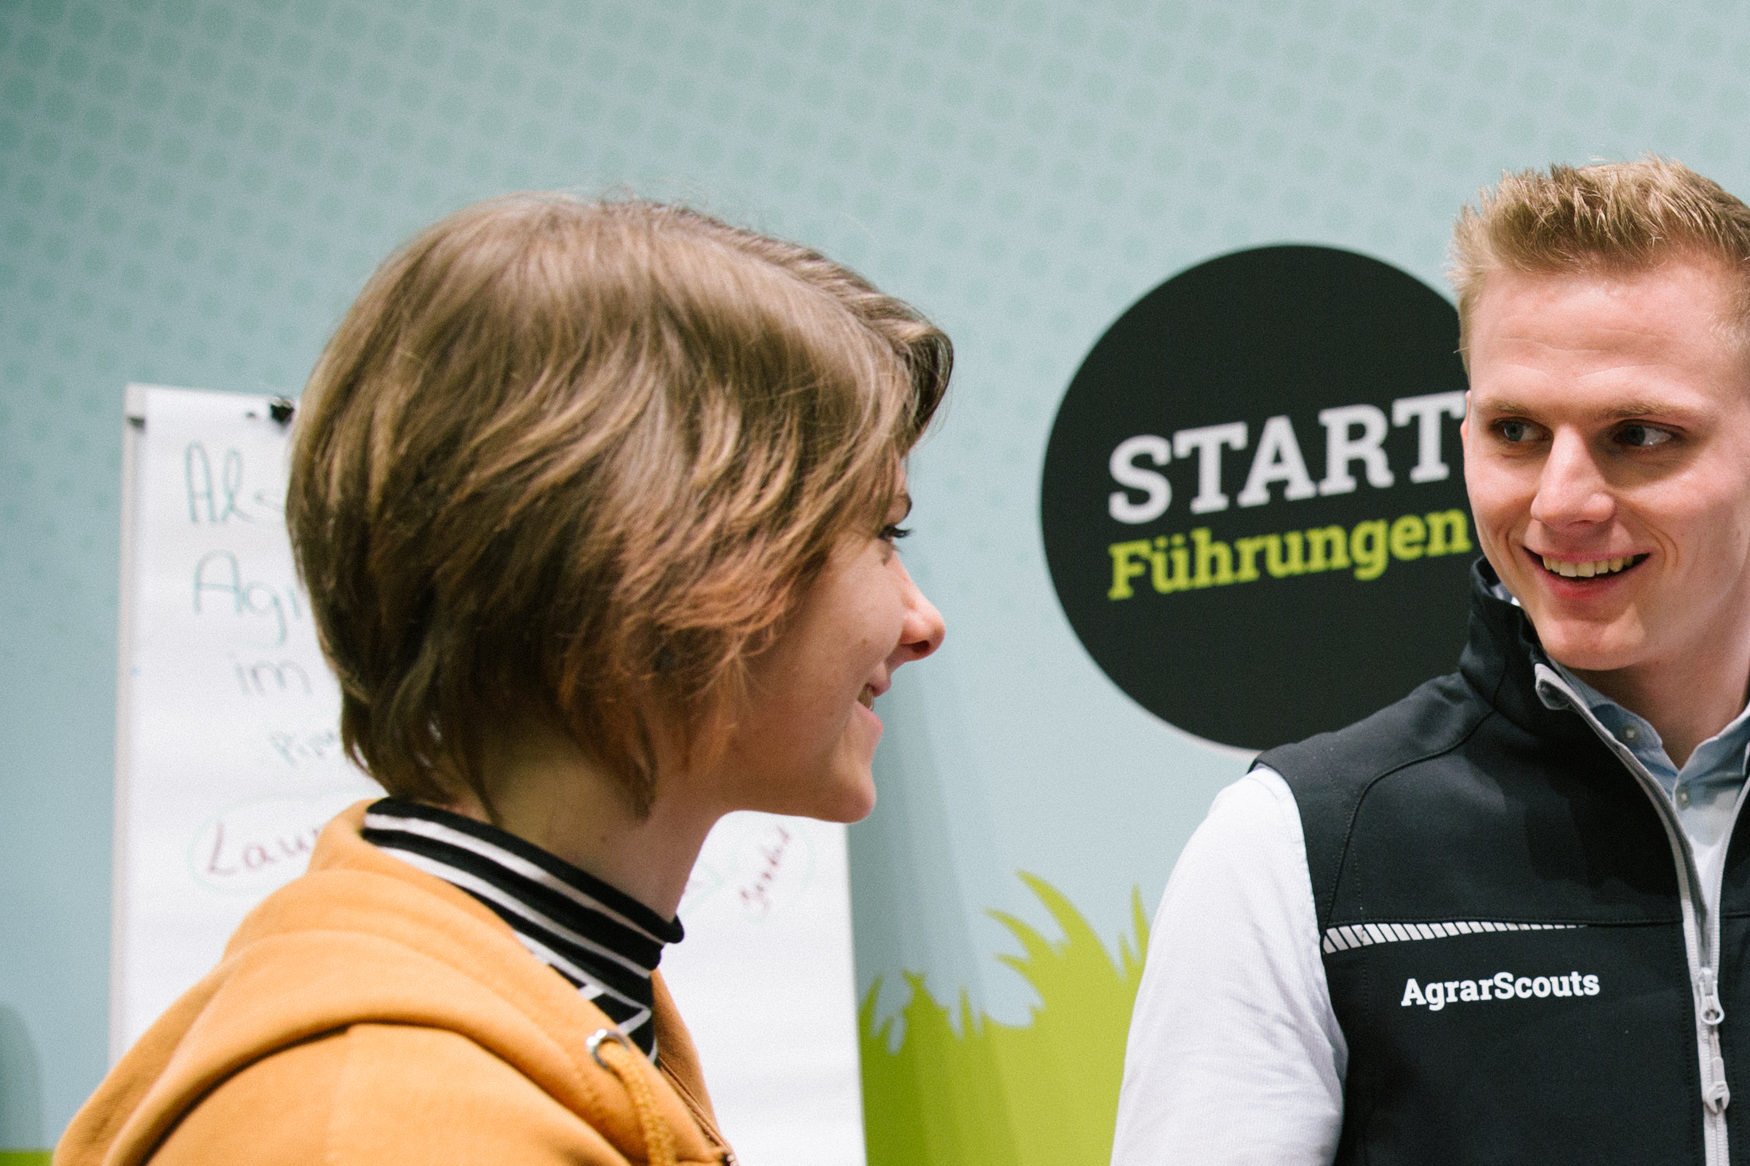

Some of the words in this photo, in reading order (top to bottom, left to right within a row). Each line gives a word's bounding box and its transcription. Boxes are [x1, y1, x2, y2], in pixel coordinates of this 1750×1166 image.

[1108, 389, 1468, 525] START
[1107, 507, 1472, 602] Führungen
[1400, 970, 1601, 1012] AgrarScouts
